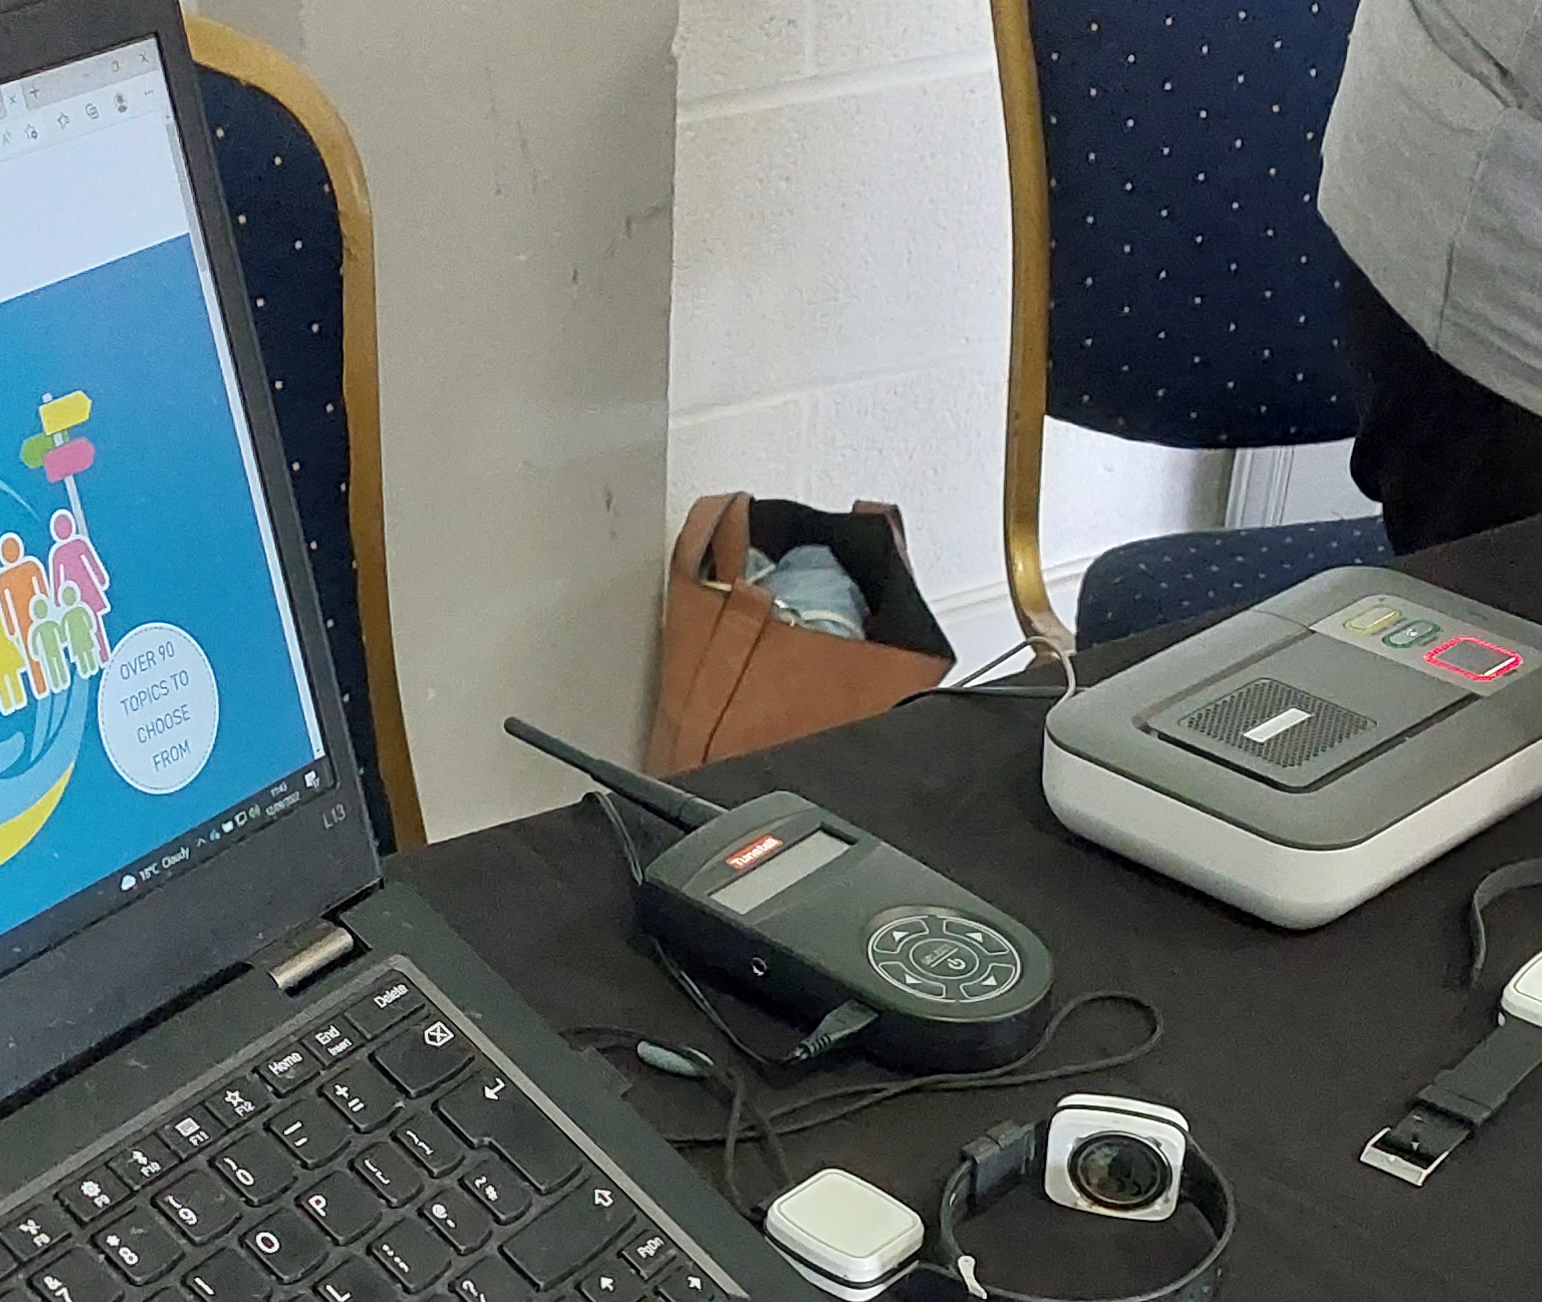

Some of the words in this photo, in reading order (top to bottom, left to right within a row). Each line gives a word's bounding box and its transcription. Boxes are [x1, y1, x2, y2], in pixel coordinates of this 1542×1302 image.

[119, 650, 158, 680] OVER
[157, 635, 174, 661] 90
[119, 679, 169, 715] TOPICS
[168, 669, 189, 691] TO
[136, 703, 190, 743] CHOOSE
[152, 738, 191, 772] FROM
[322, 803, 346, 831] L13
[373, 982, 410, 1008] Delete
[267, 1051, 303, 1076] Home
